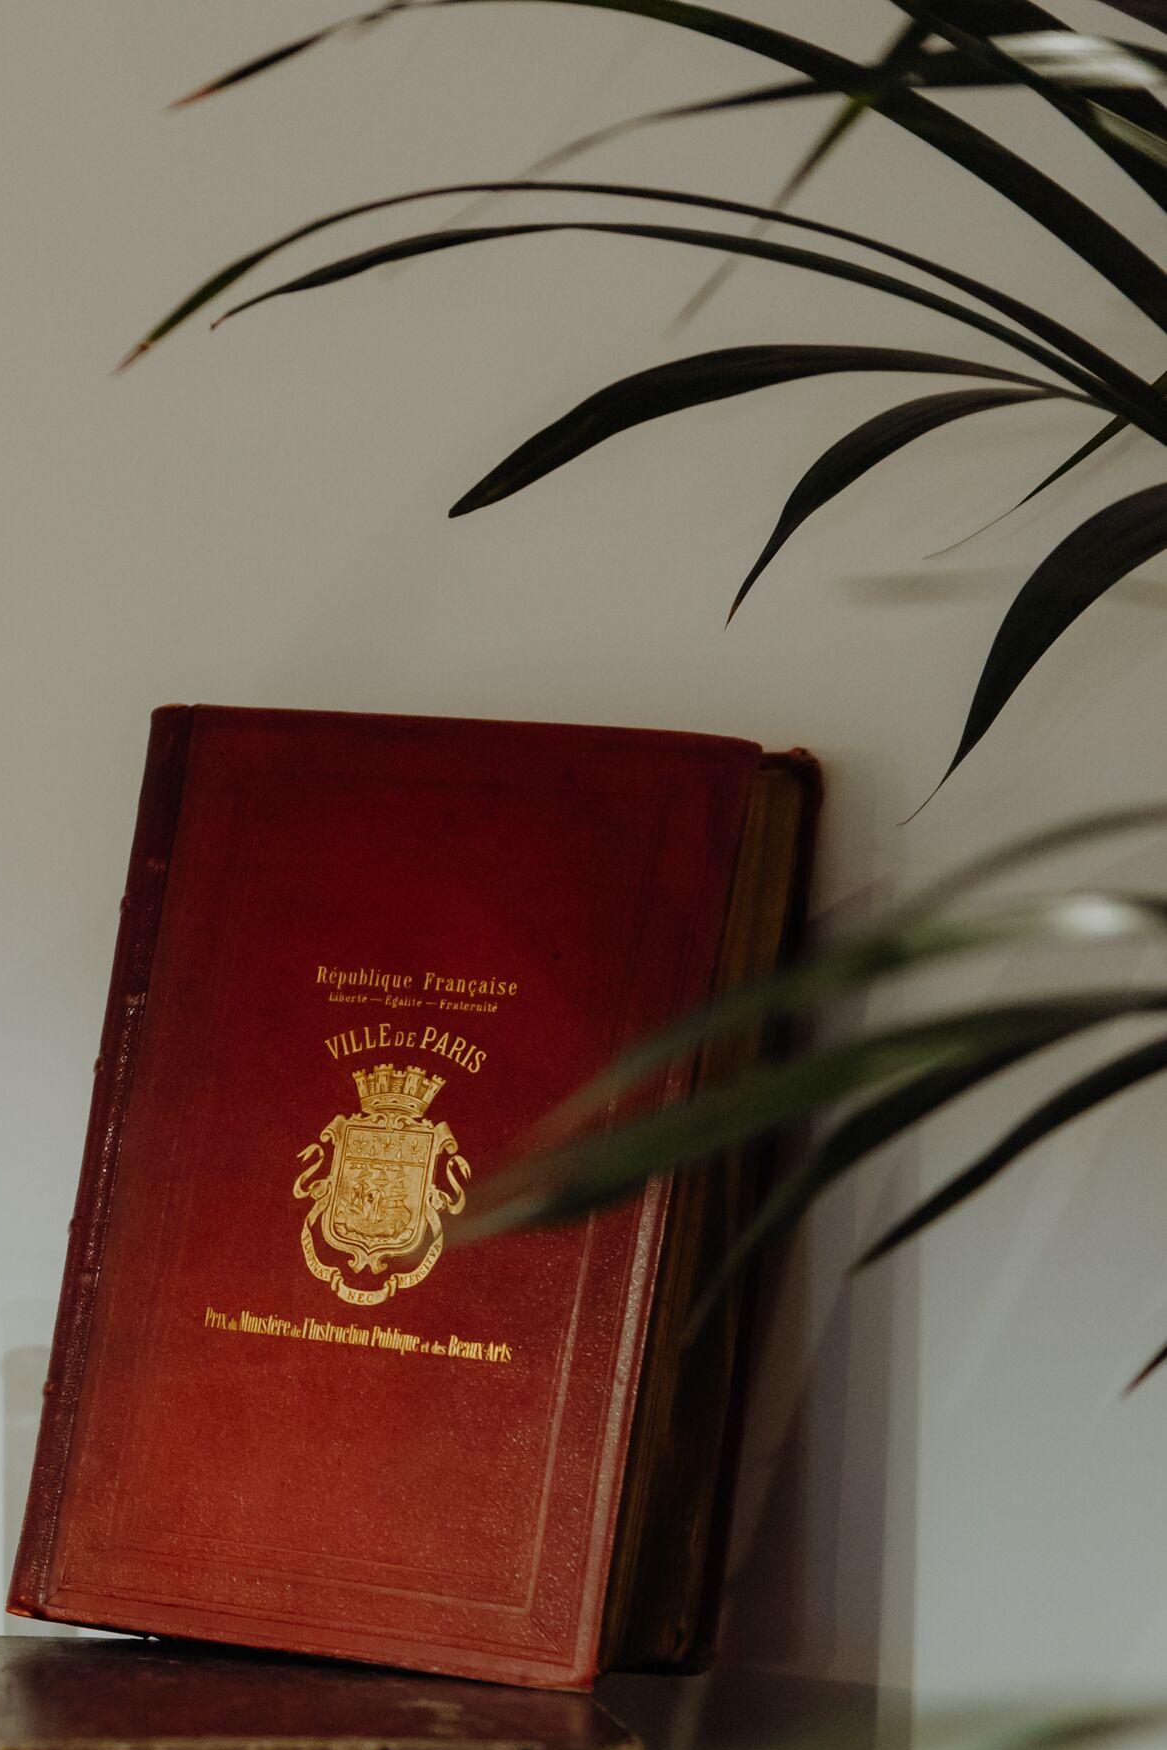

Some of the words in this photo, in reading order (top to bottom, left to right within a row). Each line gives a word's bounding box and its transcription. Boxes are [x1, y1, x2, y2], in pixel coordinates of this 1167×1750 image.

[316, 965, 413, 992] République
[423, 972, 518, 997] Française
[439, 998, 498, 1013] Fraternité
[324, 1023, 391, 1060] VILLE
[394, 1031, 417, 1048] DE
[419, 1026, 487, 1074] PARIS
[347, 1290, 374, 1303] NEC
[204, 1306, 227, 1330] Prix
[228, 1317, 237, 1331] du
[290, 1325, 302, 1338] de
[370, 1326, 421, 1356] Publique
[420, 1341, 430, 1353] et
[431, 1341, 447, 1355] des
